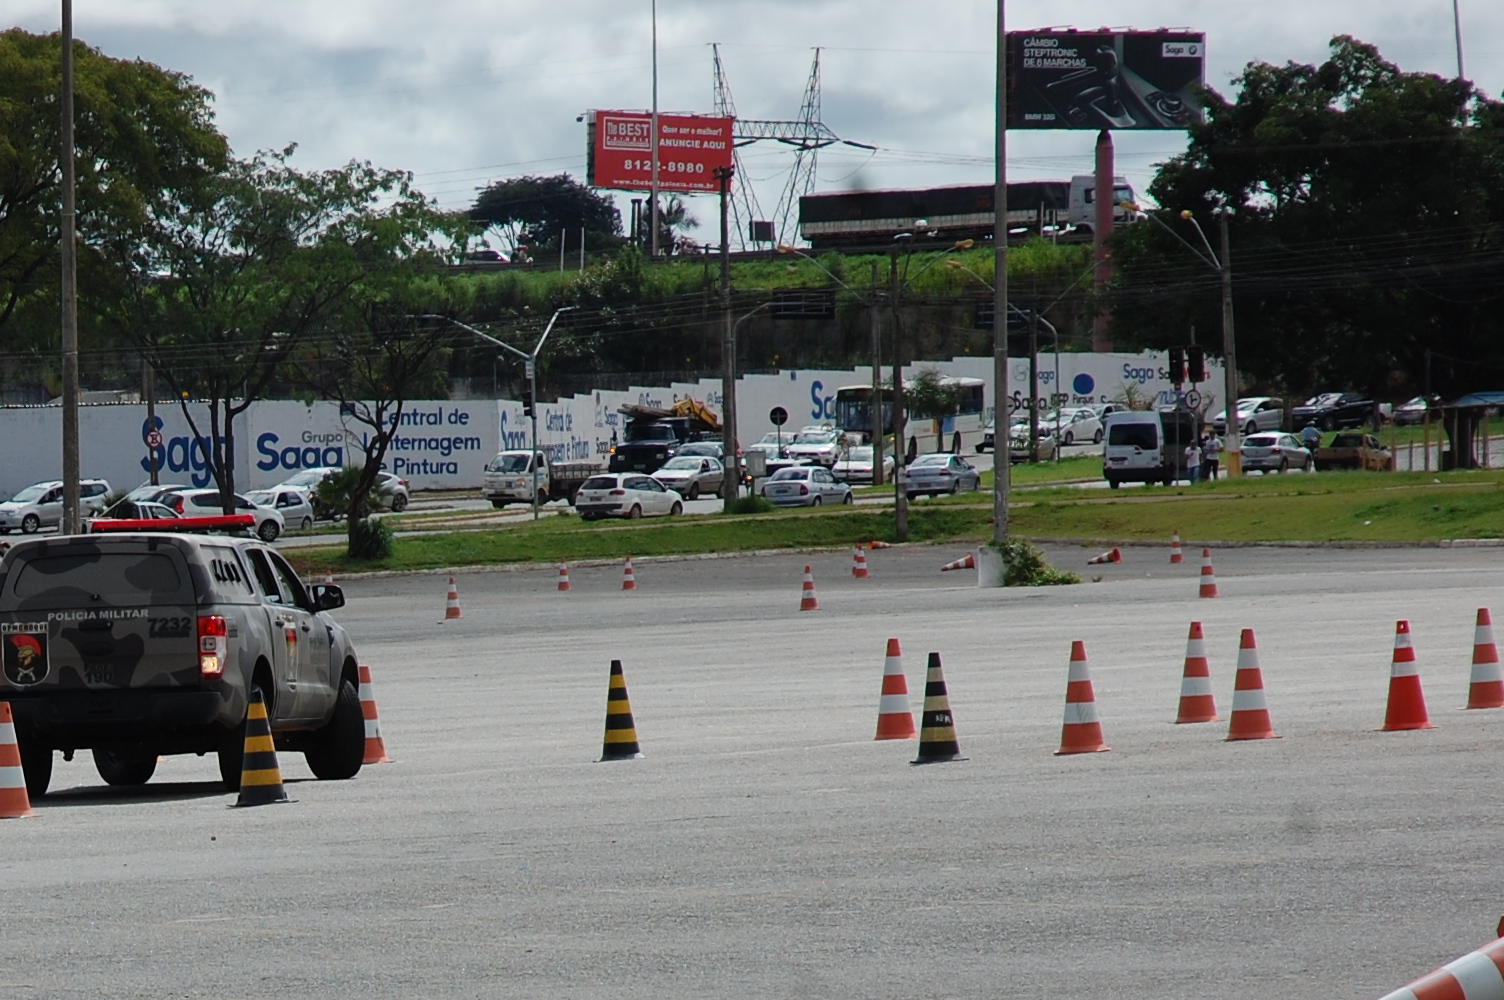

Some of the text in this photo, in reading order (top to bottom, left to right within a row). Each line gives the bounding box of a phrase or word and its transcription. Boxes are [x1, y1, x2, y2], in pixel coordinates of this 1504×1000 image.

[1024, 37, 1058, 47] CÂMBIO
[1024, 48, 1078, 57] STEPTRONIC
[1024, 58, 1036, 67] DE
[1044, 58, 1087, 67] MARCHAS
[619, 123, 649, 137] BEST
[659, 138, 701, 149] ANUNCIE
[702, 141, 726, 150] AQUI
[1039, 371, 1055, 384] aga
[1123, 363, 1154, 384] Saga
[448, 408, 470, 426] de
[302, 430, 343, 446] Grupo
[394, 457, 458, 475] Pintura
[47, 609, 149, 621] POLÍCIA MILITAR
[147, 617, 192, 632] 7232
